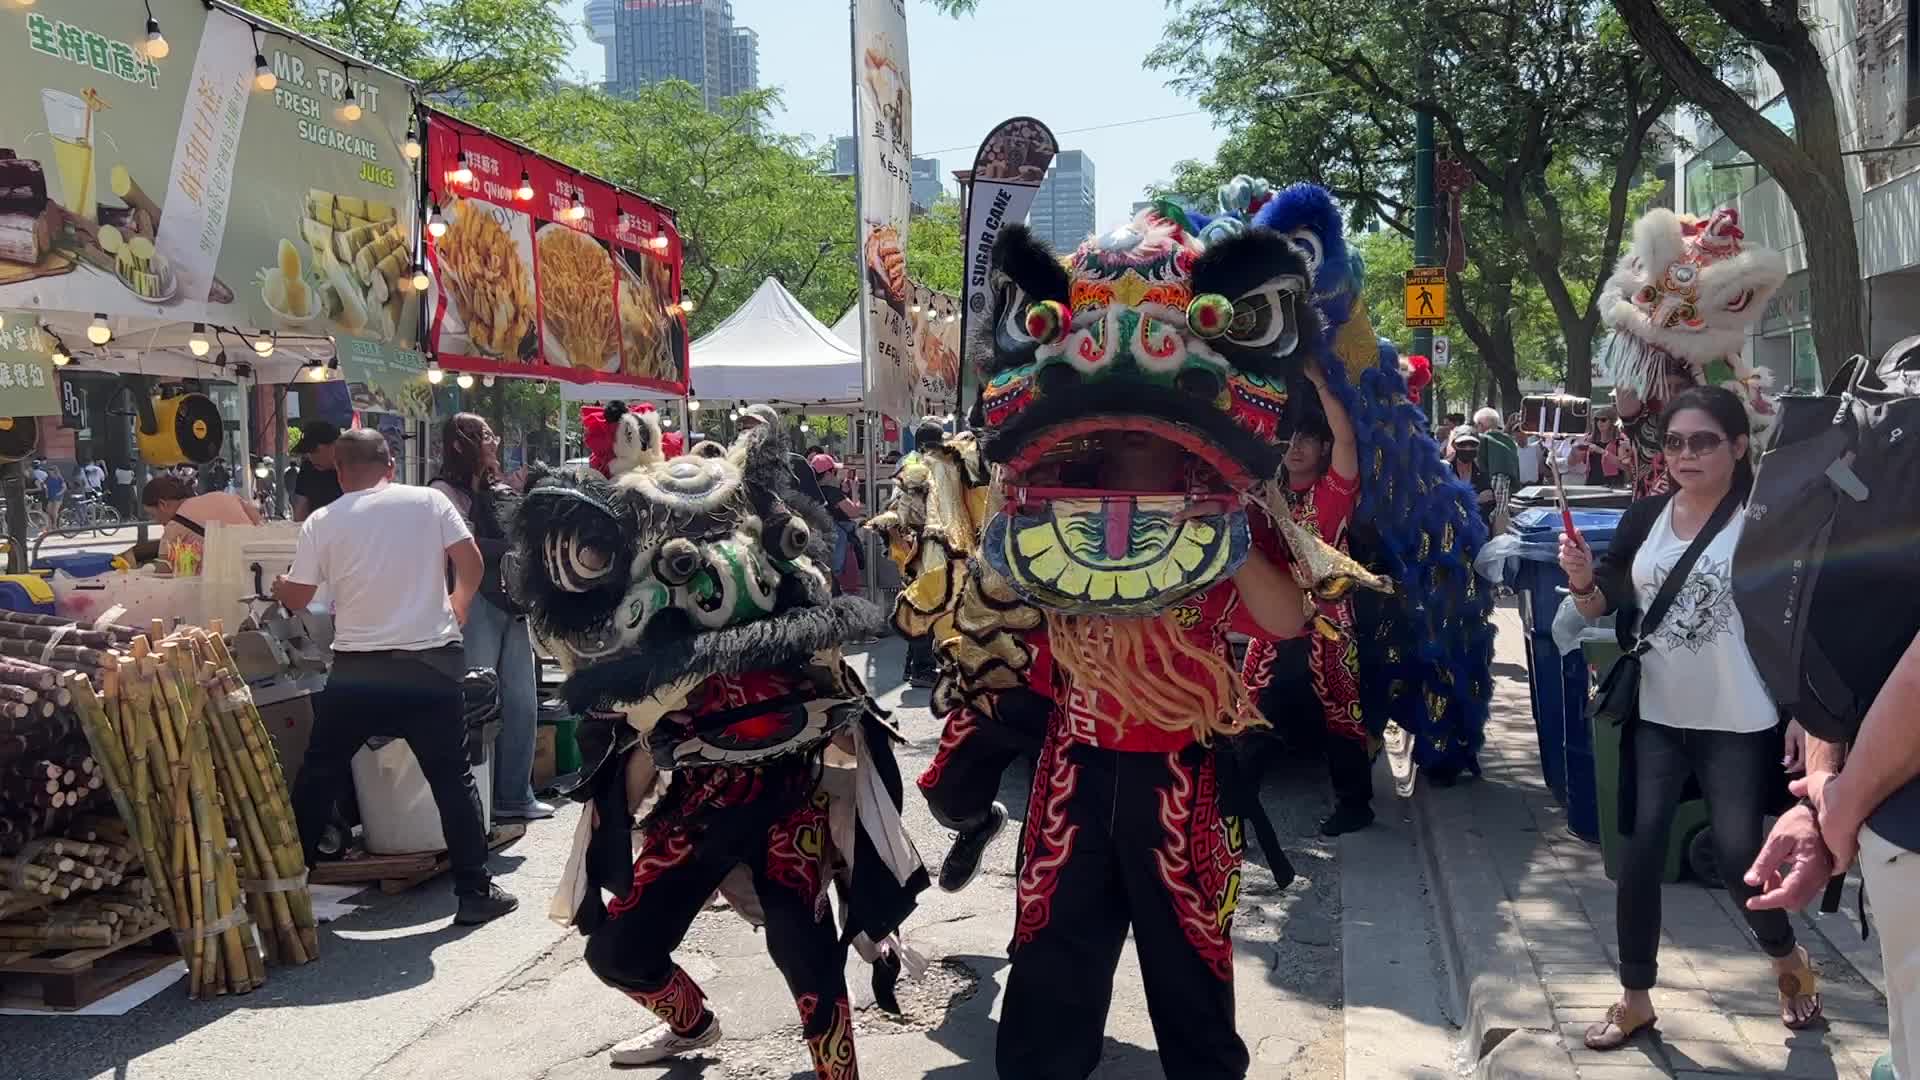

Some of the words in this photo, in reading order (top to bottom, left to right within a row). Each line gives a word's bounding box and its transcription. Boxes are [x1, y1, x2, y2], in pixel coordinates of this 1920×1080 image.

[273, 50, 313, 89] MR.
[275, 88, 320, 118] FRESH
[298, 120, 377, 160] SUGARCANE
[360, 161, 395, 187] JUICE
[972, 231, 995, 287] SUGAR
[985, 188, 1013, 231] CANE
